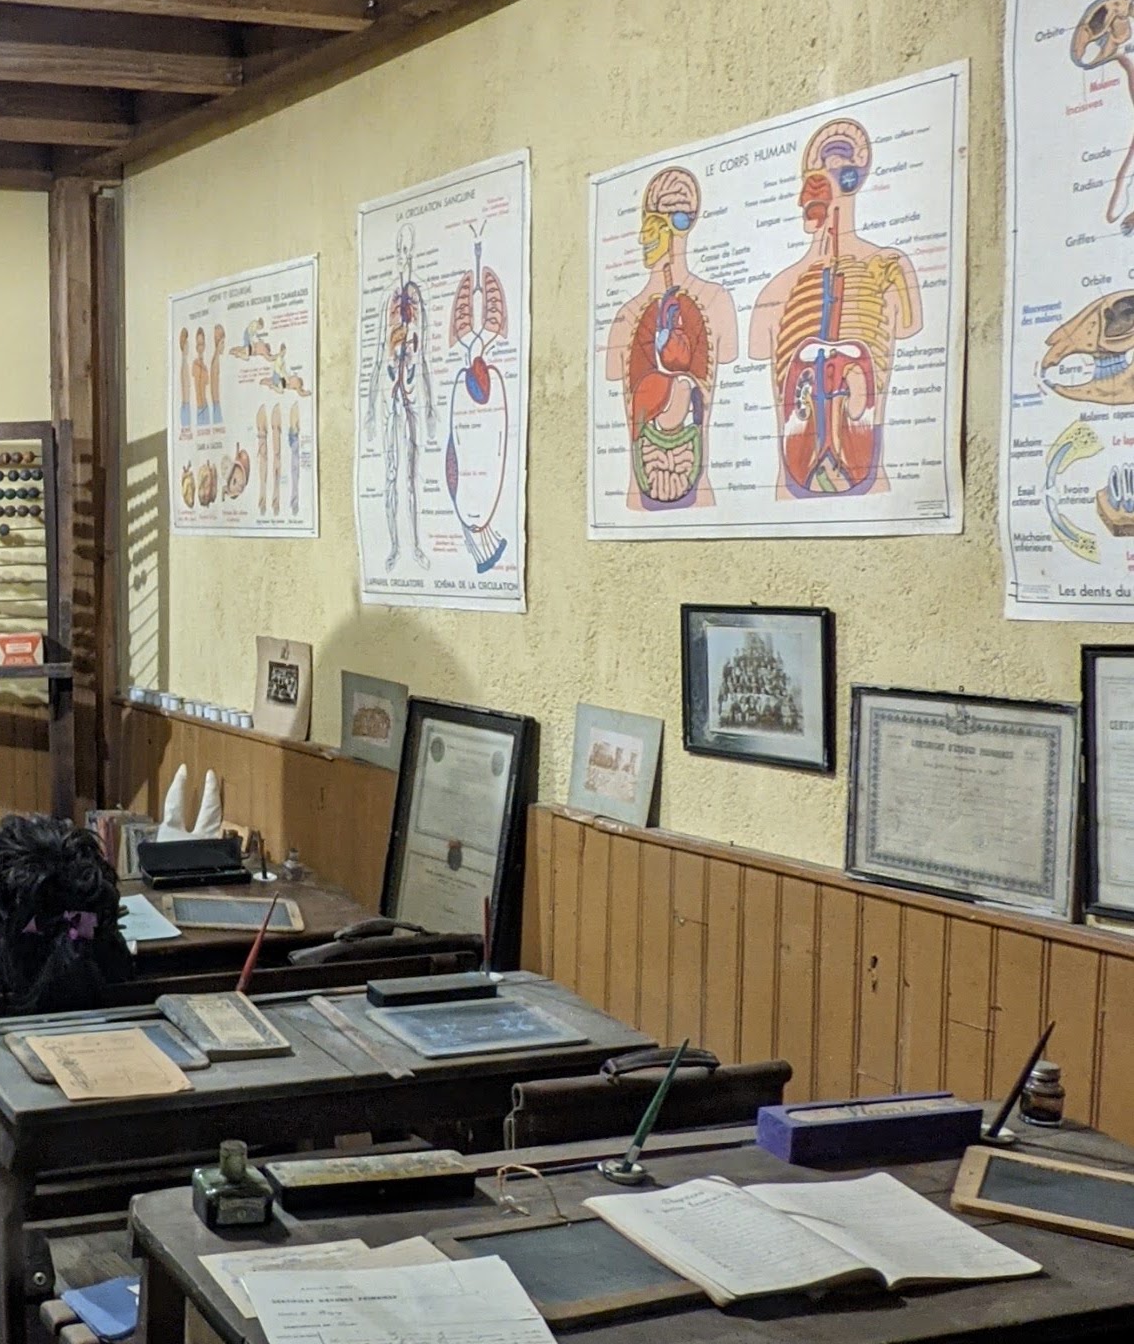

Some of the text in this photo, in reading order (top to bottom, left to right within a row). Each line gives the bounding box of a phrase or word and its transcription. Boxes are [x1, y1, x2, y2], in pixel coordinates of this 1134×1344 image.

[1035, 28, 1065, 42] Orbite
[1066, 99, 1103, 116] Incisives
[705, 141, 797, 177] LE CORPS HUMAIN
[875, 162, 908, 176] Cervelet
[1072, 179, 1104, 194] Radius
[1066, 234, 1095, 247] Griffes
[1081, 275, 1112, 287] Orbite
[896, 347, 945, 358] Diaphragme
[1059, 365, 1083, 375] Barre
[892, 385, 942, 397] Rein gauche
[1059, 585, 1076, 597] Les
[1080, 585, 1109, 598] dents
[1115, 585, 1132, 598] du
